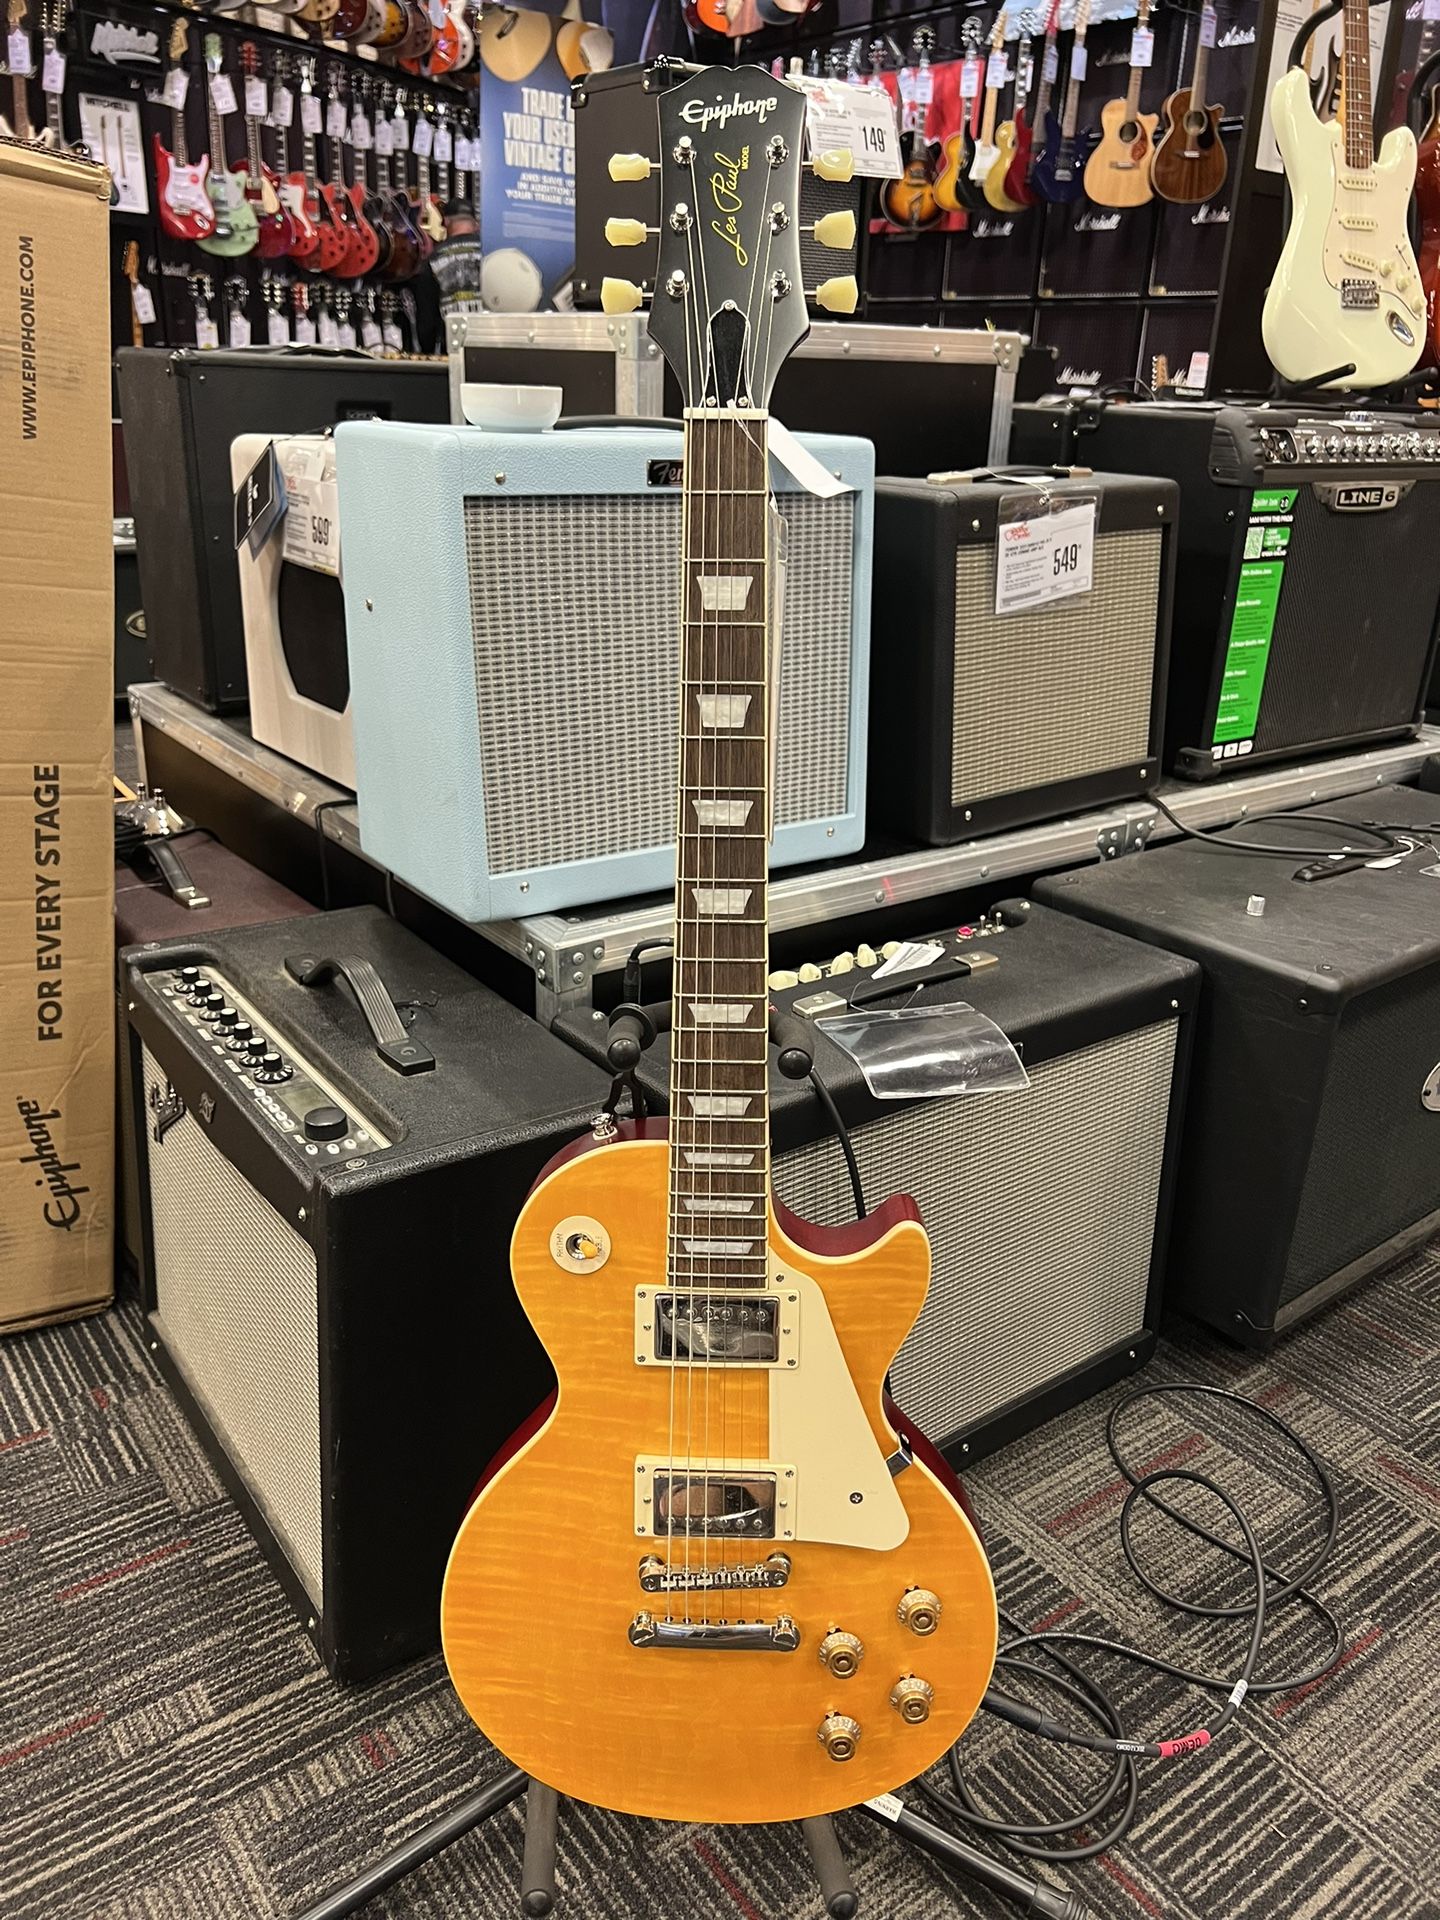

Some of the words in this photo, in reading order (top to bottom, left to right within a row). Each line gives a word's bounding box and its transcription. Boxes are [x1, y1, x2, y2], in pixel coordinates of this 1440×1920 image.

[521, 86, 565, 119] TRADE
[678, 93, 778, 133] Epiphone
[503, 112, 541, 142] YOUR
[862, 125, 886, 153] 149
[504, 139, 562, 173] VINTAGE
[741, 145, 750, 170] MODEL
[709, 152, 743, 213] Paul
[712, 216, 748, 267] Les
[19, 235, 38, 440] WWW.EPIPHONE.COM
[653, 462, 684, 484] Fen
[1339, 490, 1382, 504] LINE
[1385, 490, 1396, 502] 6
[1053, 543, 1078, 576] 549
[34, 763, 61, 867] STAGE
[36, 875, 62, 971] EVERY
[37, 979, 63, 1042] FOR
[18, 1098, 90, 1232] Epiphone
[1172, 1736, 1202, 1755] DEMO
